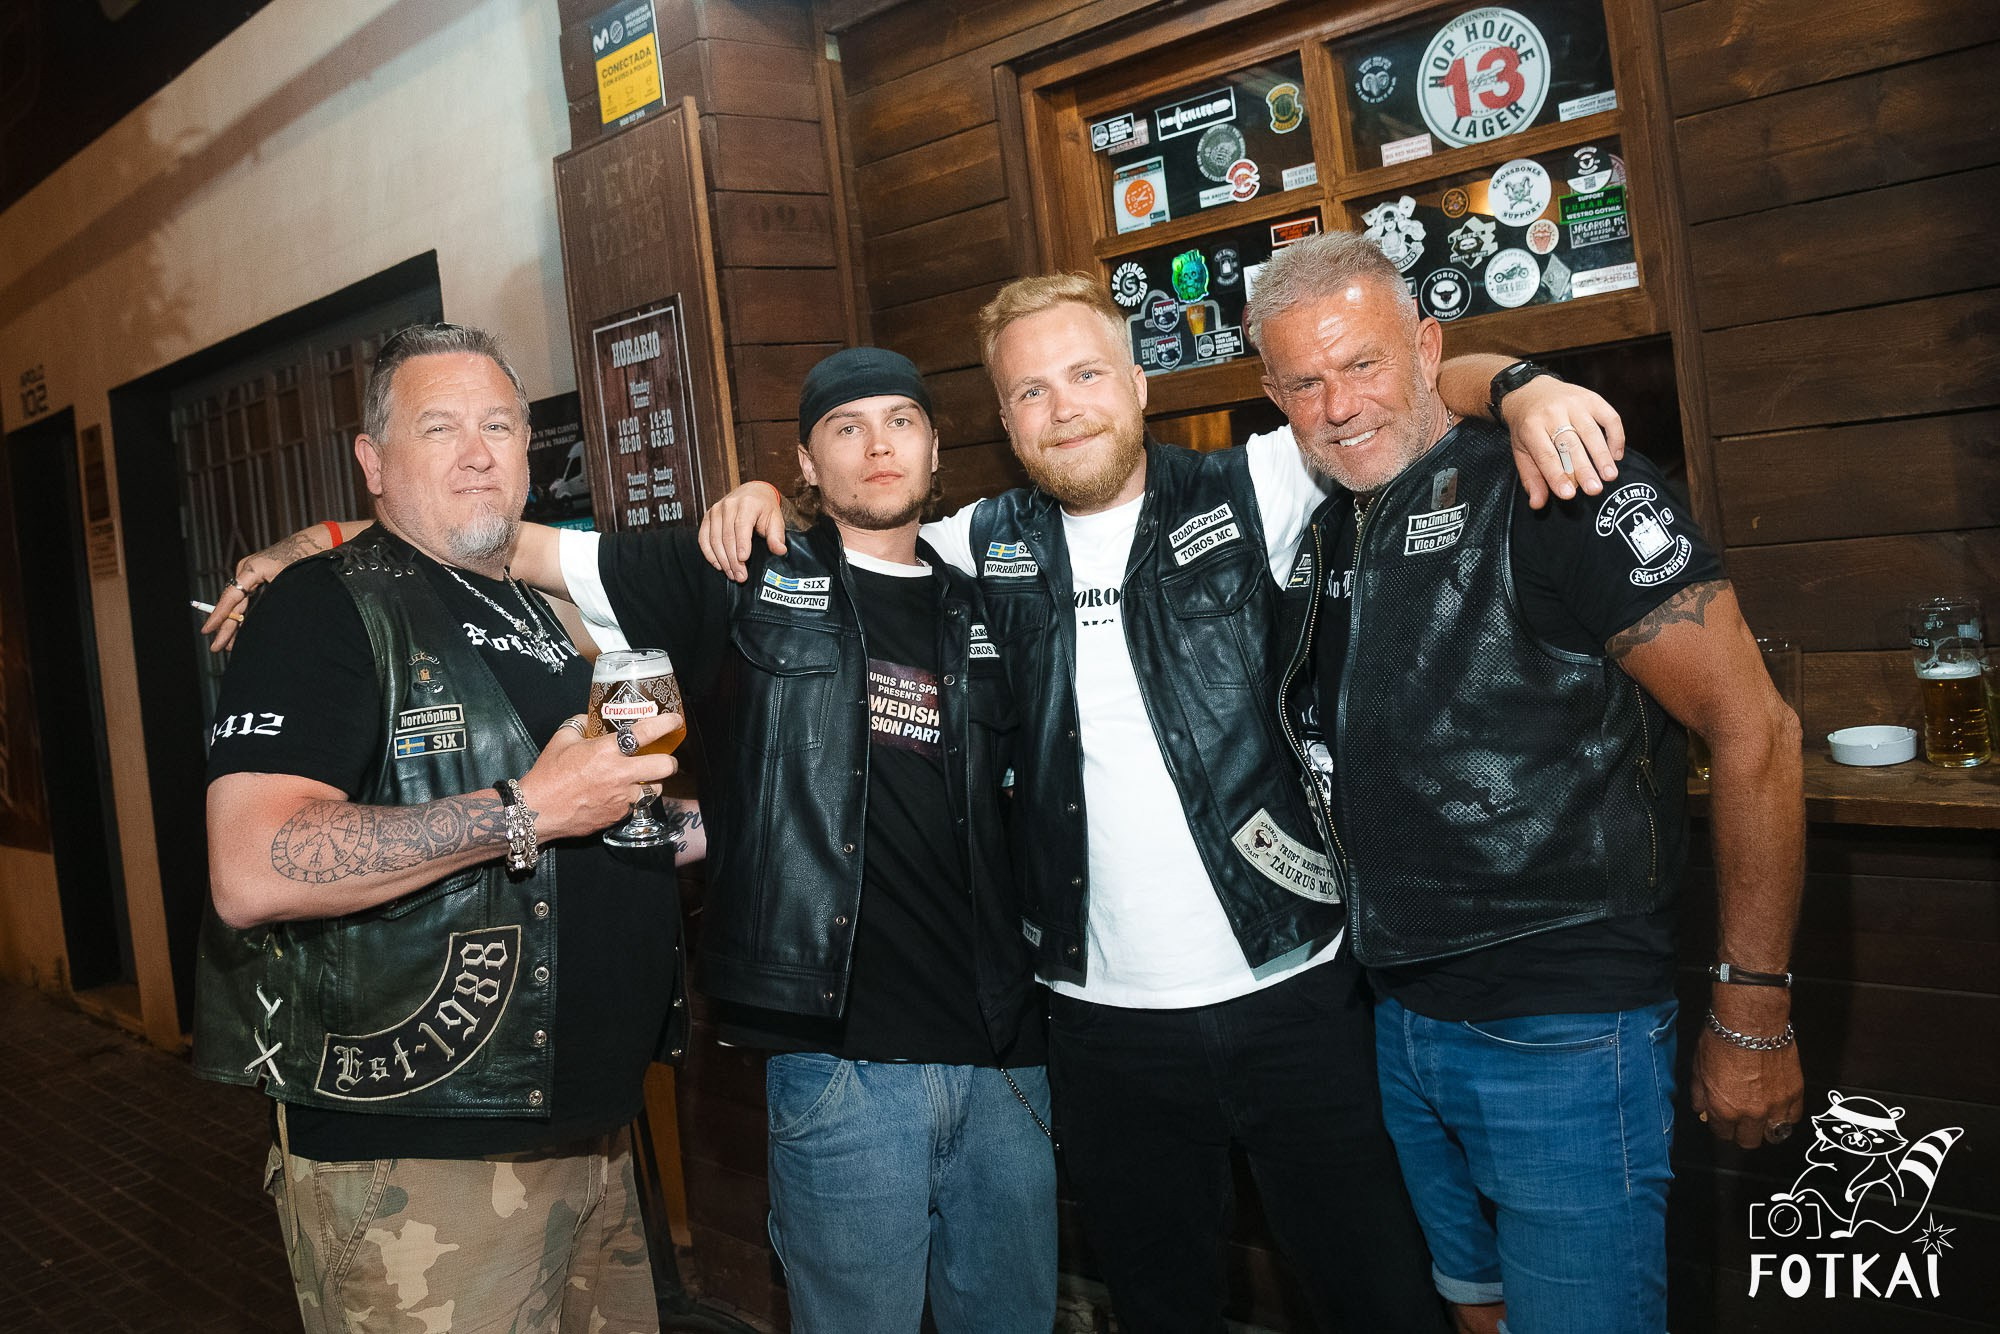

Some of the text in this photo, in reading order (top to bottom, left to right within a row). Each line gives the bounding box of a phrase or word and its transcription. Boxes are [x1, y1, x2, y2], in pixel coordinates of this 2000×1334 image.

[1454, 10, 1500, 28] GUINNESS
[602, 46, 651, 78] CONECTADA
[1429, 39, 1457, 88] HOP
[1464, 19, 1536, 65] HOUSE
[1440, 46, 1525, 118] 13
[1451, 101, 1526, 138] LAGER
[1492, 166, 1541, 189] CROSSBONES
[1578, 192, 1604, 201] SUPPORT
[1606, 196, 1621, 205] MC
[1503, 202, 1541, 219] SUPPORT
[1567, 205, 1621, 219] WESTRO GOTHIA
[1432, 272, 1459, 282] TOROS
[1154, 307, 1163, 316] 30
[1434, 307, 1460, 318] SUPPORT
[611, 330, 660, 368] HORARIO
[1157, 344, 1166, 353] 30
[630, 380, 650, 396] Monday
[618, 408, 672, 436] 10:00 14:30
[620, 427, 674, 455] 20:00 03:30
[654, 466, 673, 482] Sunday
[627, 501, 682, 526] 20:00 03:30
[1599, 486, 1650, 528] No Limit
[1172, 508, 1228, 544] ROADCAPTAIN
[1428, 514, 1449, 528] Limit
[1181, 528, 1233, 560] TOROS MC
[1414, 538, 1435, 550] Vice
[985, 563, 1037, 574] NORRKÖPING
[1634, 538, 1688, 583] Norrköping
[803, 580, 826, 589] SIX
[763, 589, 825, 607] NORRKÖPING
[869, 672, 938, 696] URUS MC SPA
[878, 685, 922, 701] PRESENTS
[401, 710, 457, 728] Norrköping
[604, 704, 654, 716] Cruzcampo
[870, 695, 940, 727] WEDISH
[871, 716, 902, 735] SION
[432, 733, 458, 750] SIX
[1260, 821, 1279, 843] TAURUS
[1280, 844, 1301, 863] TRUST
[1270, 855, 1316, 891] TAURUS
[1318, 880, 1334, 895] MC
